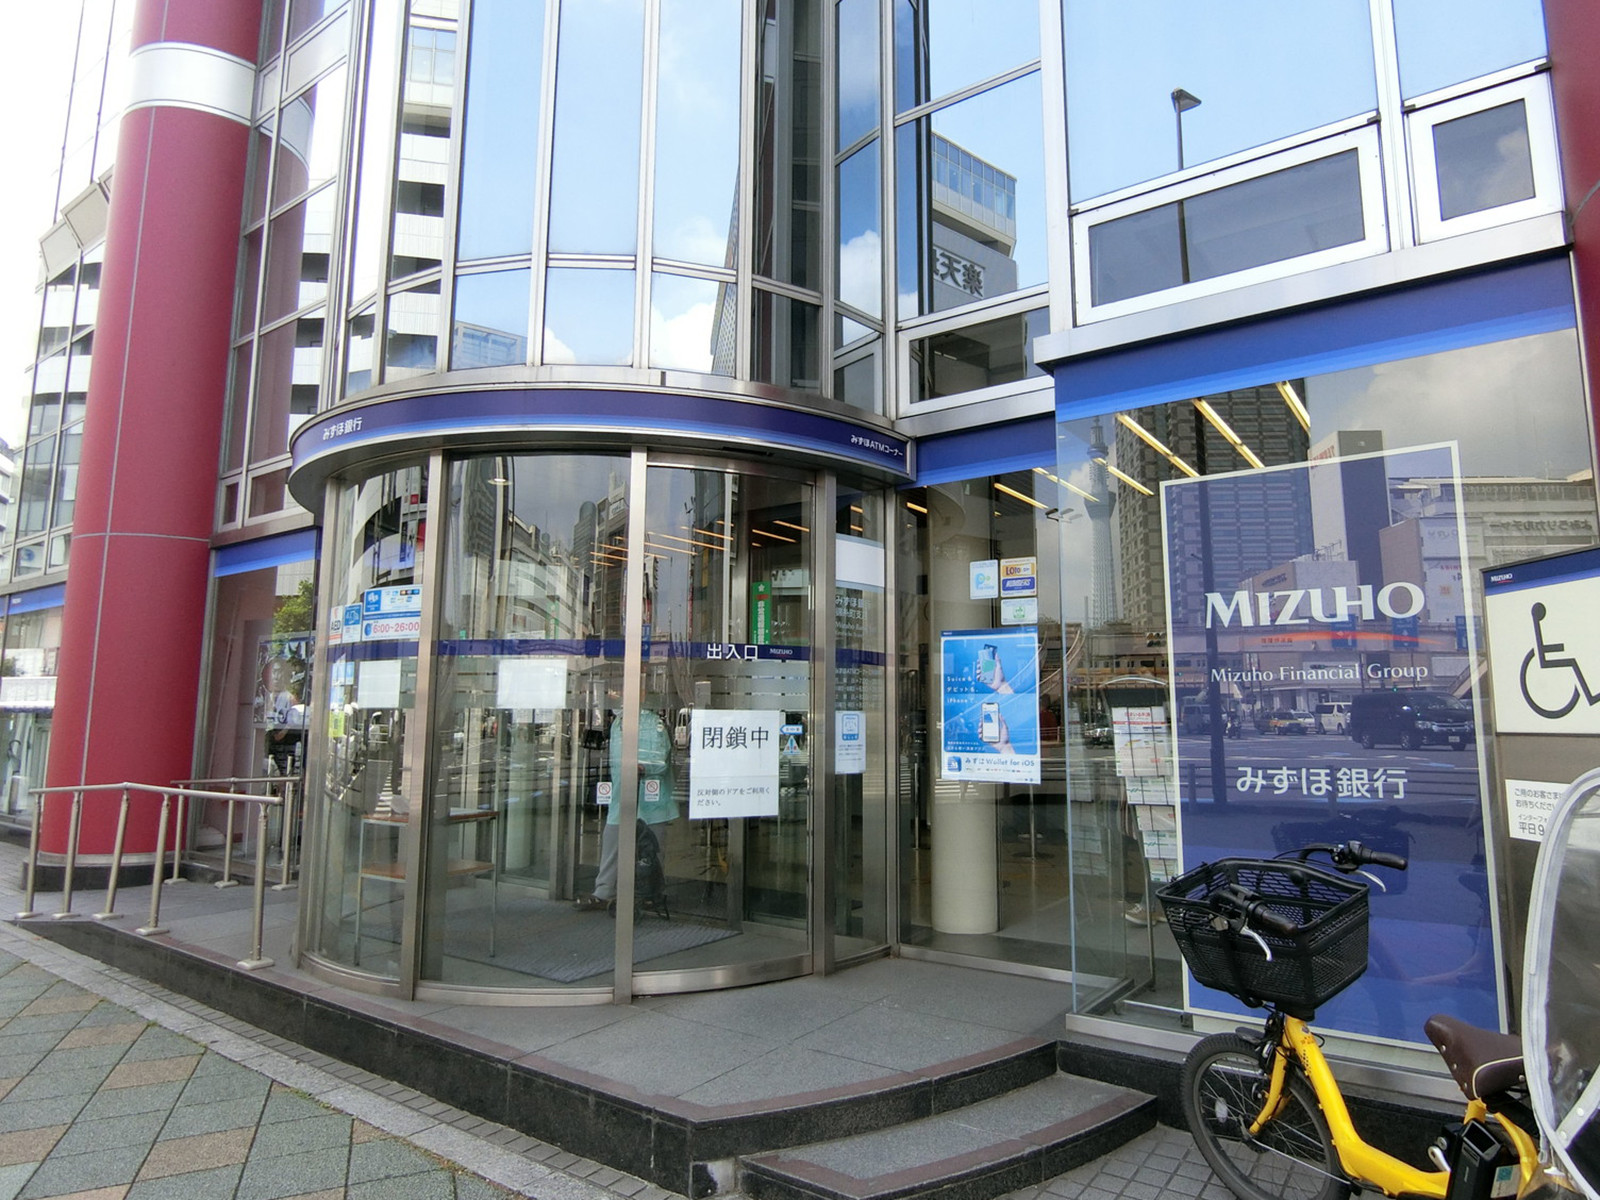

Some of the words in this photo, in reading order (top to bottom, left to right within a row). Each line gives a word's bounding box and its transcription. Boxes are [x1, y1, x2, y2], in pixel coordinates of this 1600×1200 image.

[323, 417, 362, 441] みずほ銀行
[850, 434, 903, 456] みずほATMコーナー
[1490, 573, 1513, 582] MIZUHO
[1205, 582, 1425, 629] MIZUHO
[706, 644, 759, 661] 出入口
[769, 647, 793, 655] MIZUHO
[1211, 668, 1273, 683] Mizuho
[1280, 664, 1360, 681] Financial
[1367, 663, 1429, 682] Group
[702, 726, 769, 750] 閉鎖中
[986, 758, 1008, 766] Wallet
[1236, 766, 1408, 799] みずほ銀行
[697, 787, 770, 797] 反対側のドアをご利用く
[697, 799, 722, 807] ださい。
